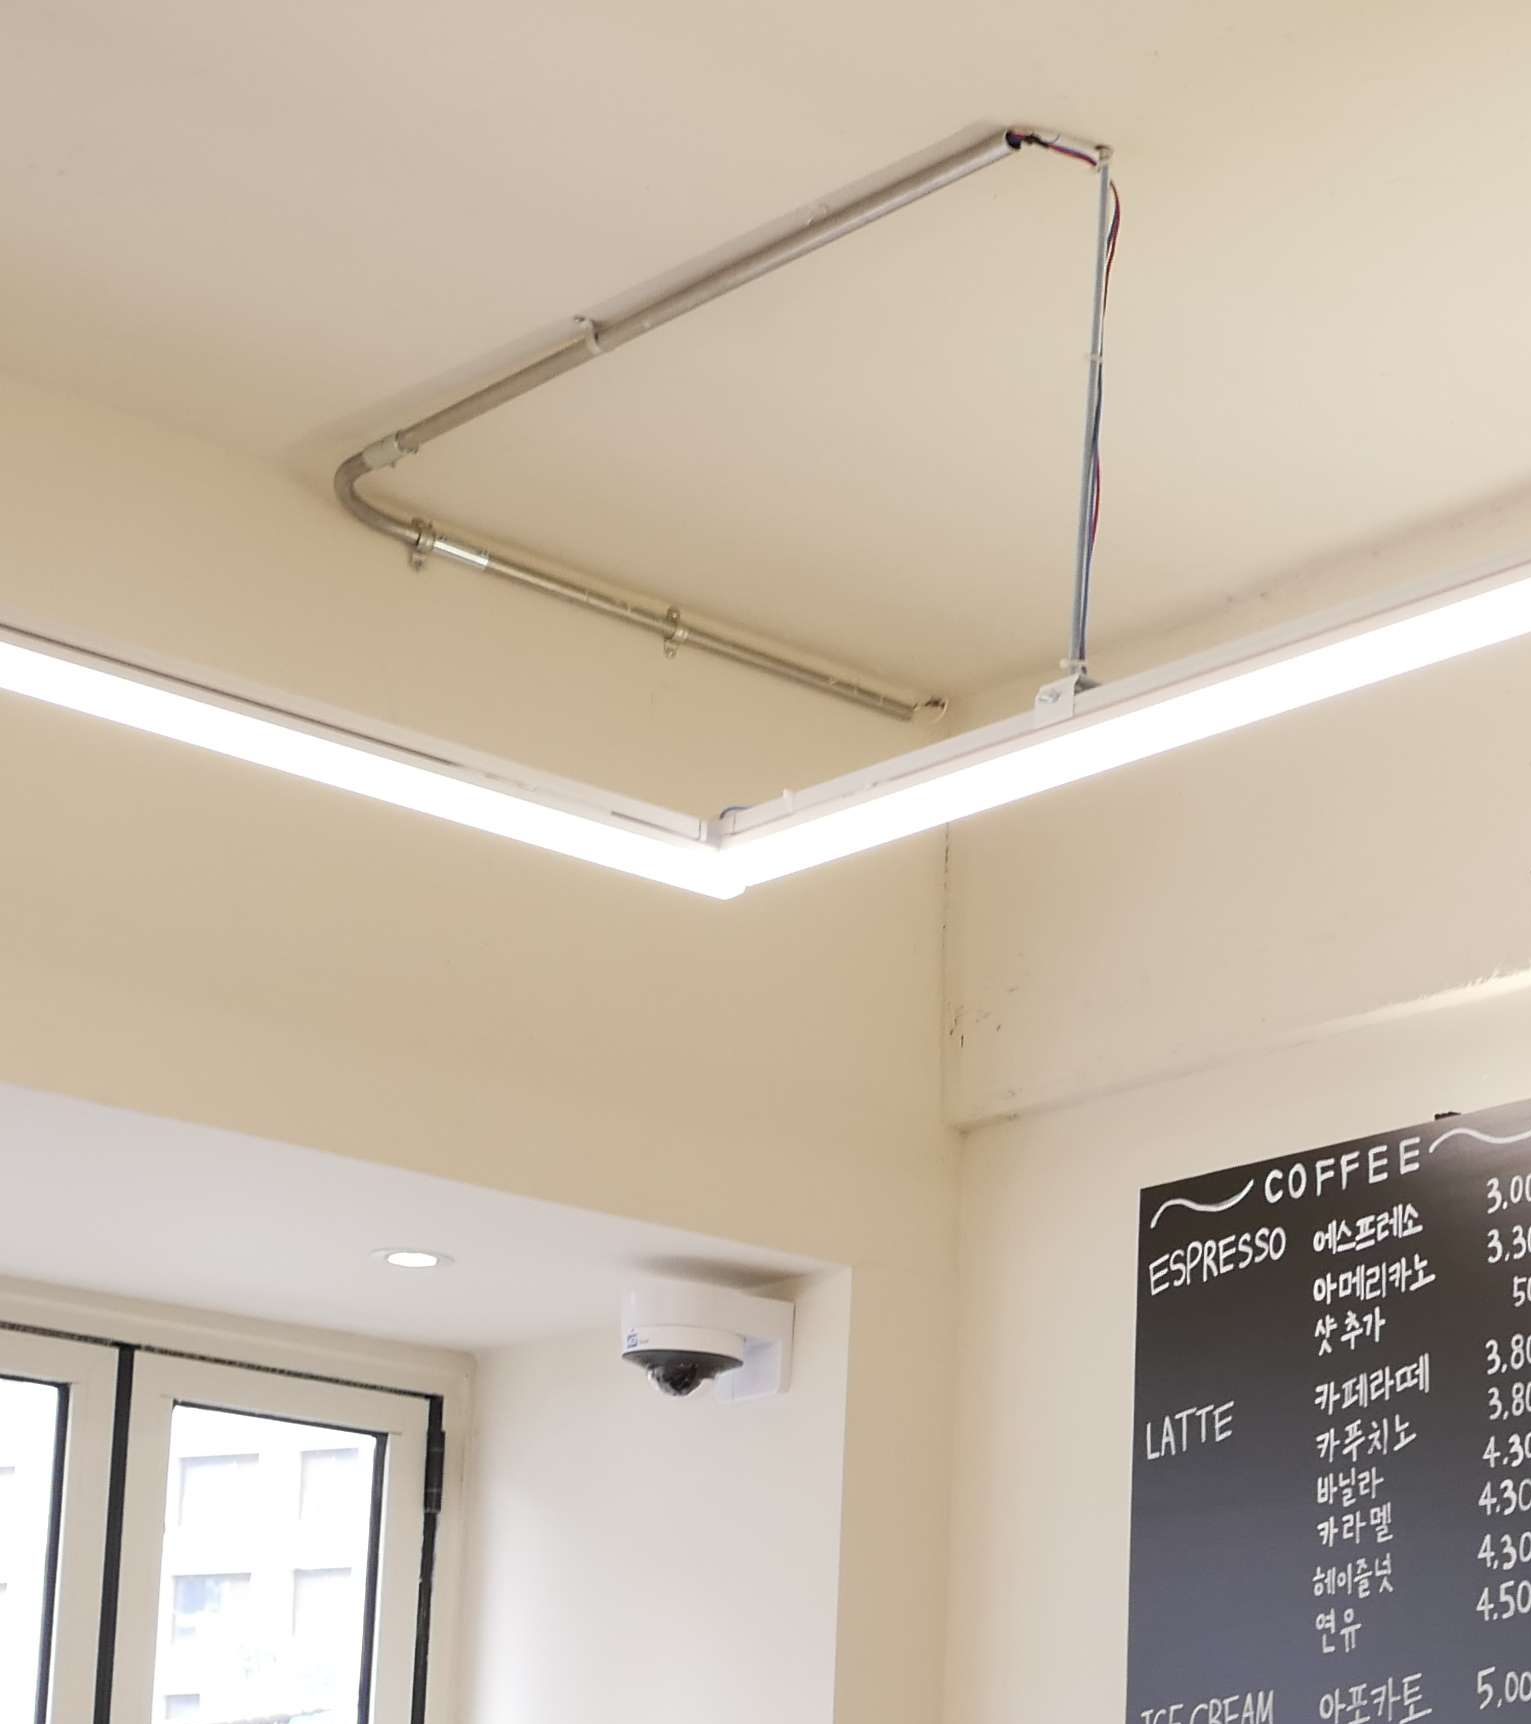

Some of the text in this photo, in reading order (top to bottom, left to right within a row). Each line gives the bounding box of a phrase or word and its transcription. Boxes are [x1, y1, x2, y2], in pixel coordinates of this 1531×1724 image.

[1265, 1137, 1420, 1203] COFFEE
[1149, 1227, 1286, 1296] ESPRESSO
[1313, 1203, 1423, 1254] 에스프레소
[1313, 1253, 1436, 1305] 아메리카노
[1315, 1314, 1338, 1356] 샷
[1340, 1306, 1386, 1350] 추가
[1147, 1401, 1234, 1460] LATTE
[1315, 1353, 1429, 1415] 카페라떼
[1316, 1414, 1416, 1463] 카푸치노
[1317, 1467, 1384, 1507] 바닐라
[1317, 1502, 1393, 1547] 카라멜
[1312, 1553, 1393, 1598] 헤이즐넛
[1316, 1608, 1362, 1653] 연유
